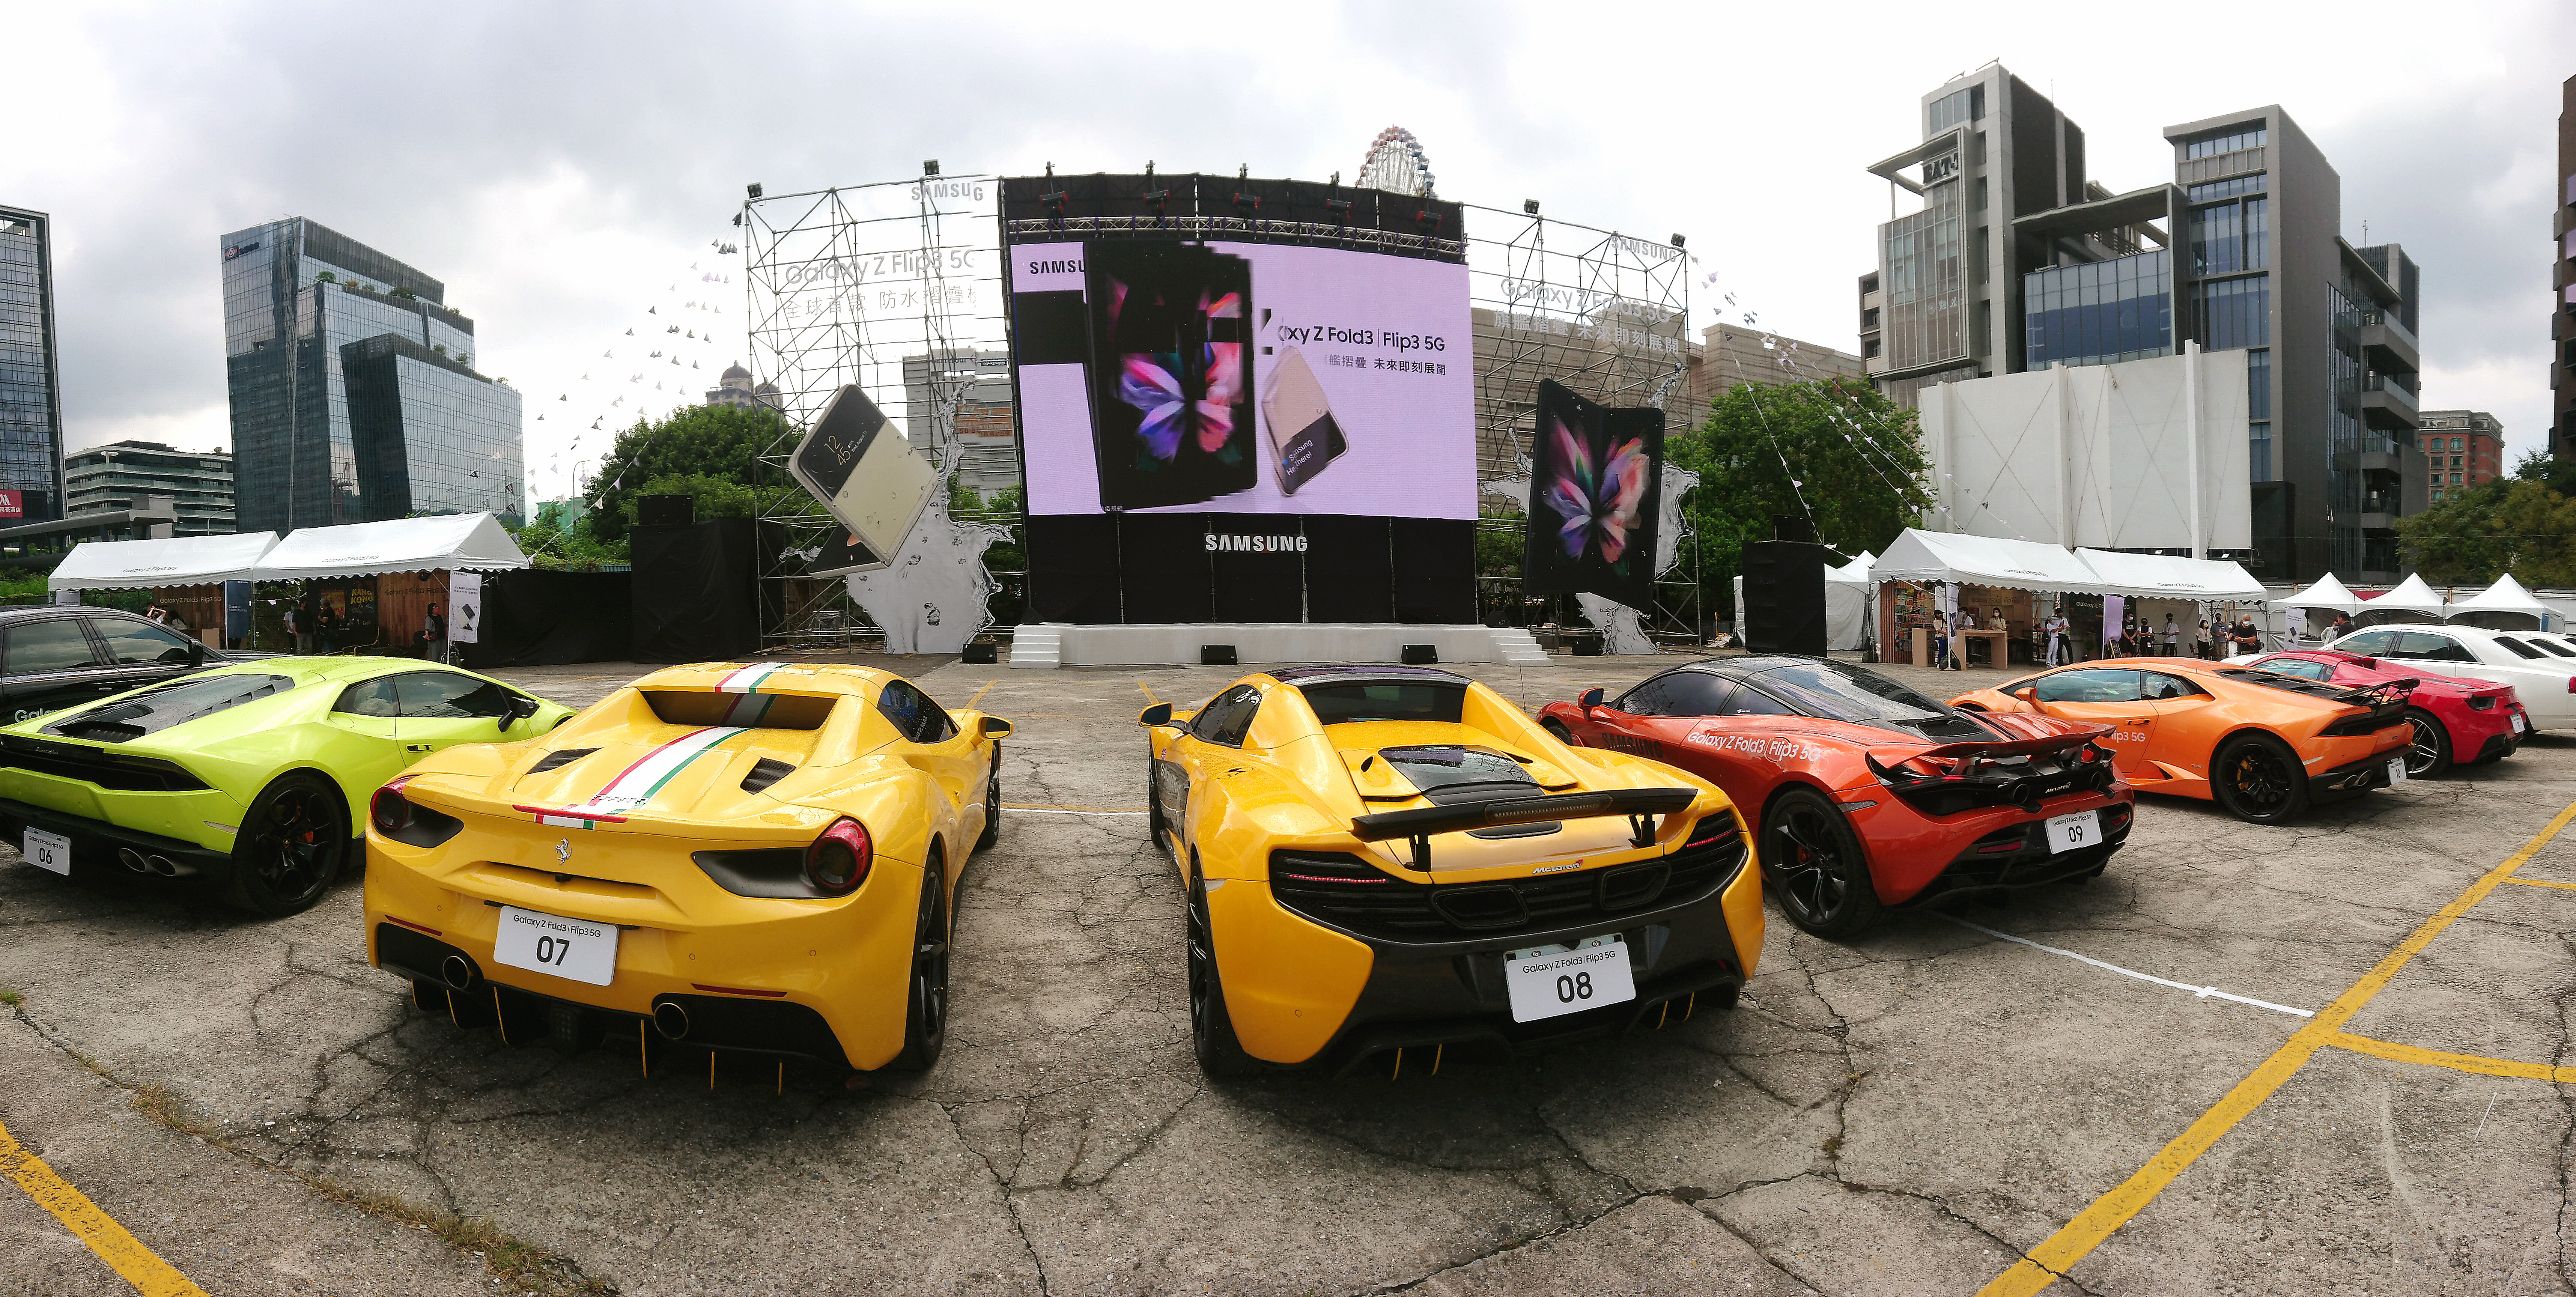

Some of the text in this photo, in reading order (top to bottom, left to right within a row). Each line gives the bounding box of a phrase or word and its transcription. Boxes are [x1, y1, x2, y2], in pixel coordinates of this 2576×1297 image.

[1611, 235, 1676, 262] SAMSUNG
[786, 261, 868, 284] Galaxy
[874, 256, 885, 275] Z
[892, 250, 943, 278] Flip3
[786, 293, 866, 319] 全球首款
[1501, 278, 1671, 323] Galaxy Z Fold3 5G
[1314, 326, 1324, 341] Z
[1329, 327, 1373, 345] Fold3
[1384, 331, 1420, 353] Flip3
[1425, 336, 1445, 352] 5G
[1494, 309, 1679, 355] 旗艦摺疊 未來即刻展開
[1374, 358, 1446, 375] 未來即刻展開
[824, 435, 841, 453] 12
[837, 446, 851, 465] 45
[1205, 535, 1308, 552] SAMSUNG
[1602, 732, 1663, 758] SAMSUNG
[1688, 732, 1821, 762] Galaxy Z Fold3 Flip3 5G
[2132, 732, 2146, 742] 5G
[2395, 769, 2401, 778] 10
[2045, 784, 2069, 794] McLaren
[2068, 825, 2083, 843] 09
[39, 847, 52, 865] 06
[1532, 863, 1580, 874] McLaren
[513, 915, 540, 928] Galaxy
[570, 925, 588, 937] Flip3
[536, 936, 570, 966] 07
[1523, 962, 1554, 973] Galaxy
[1561, 957, 1583, 967] Fold3
[1586, 952, 1604, 964] Flip3
[1605, 950, 1616, 959] 5G
[1556, 972, 1593, 1003] 08
